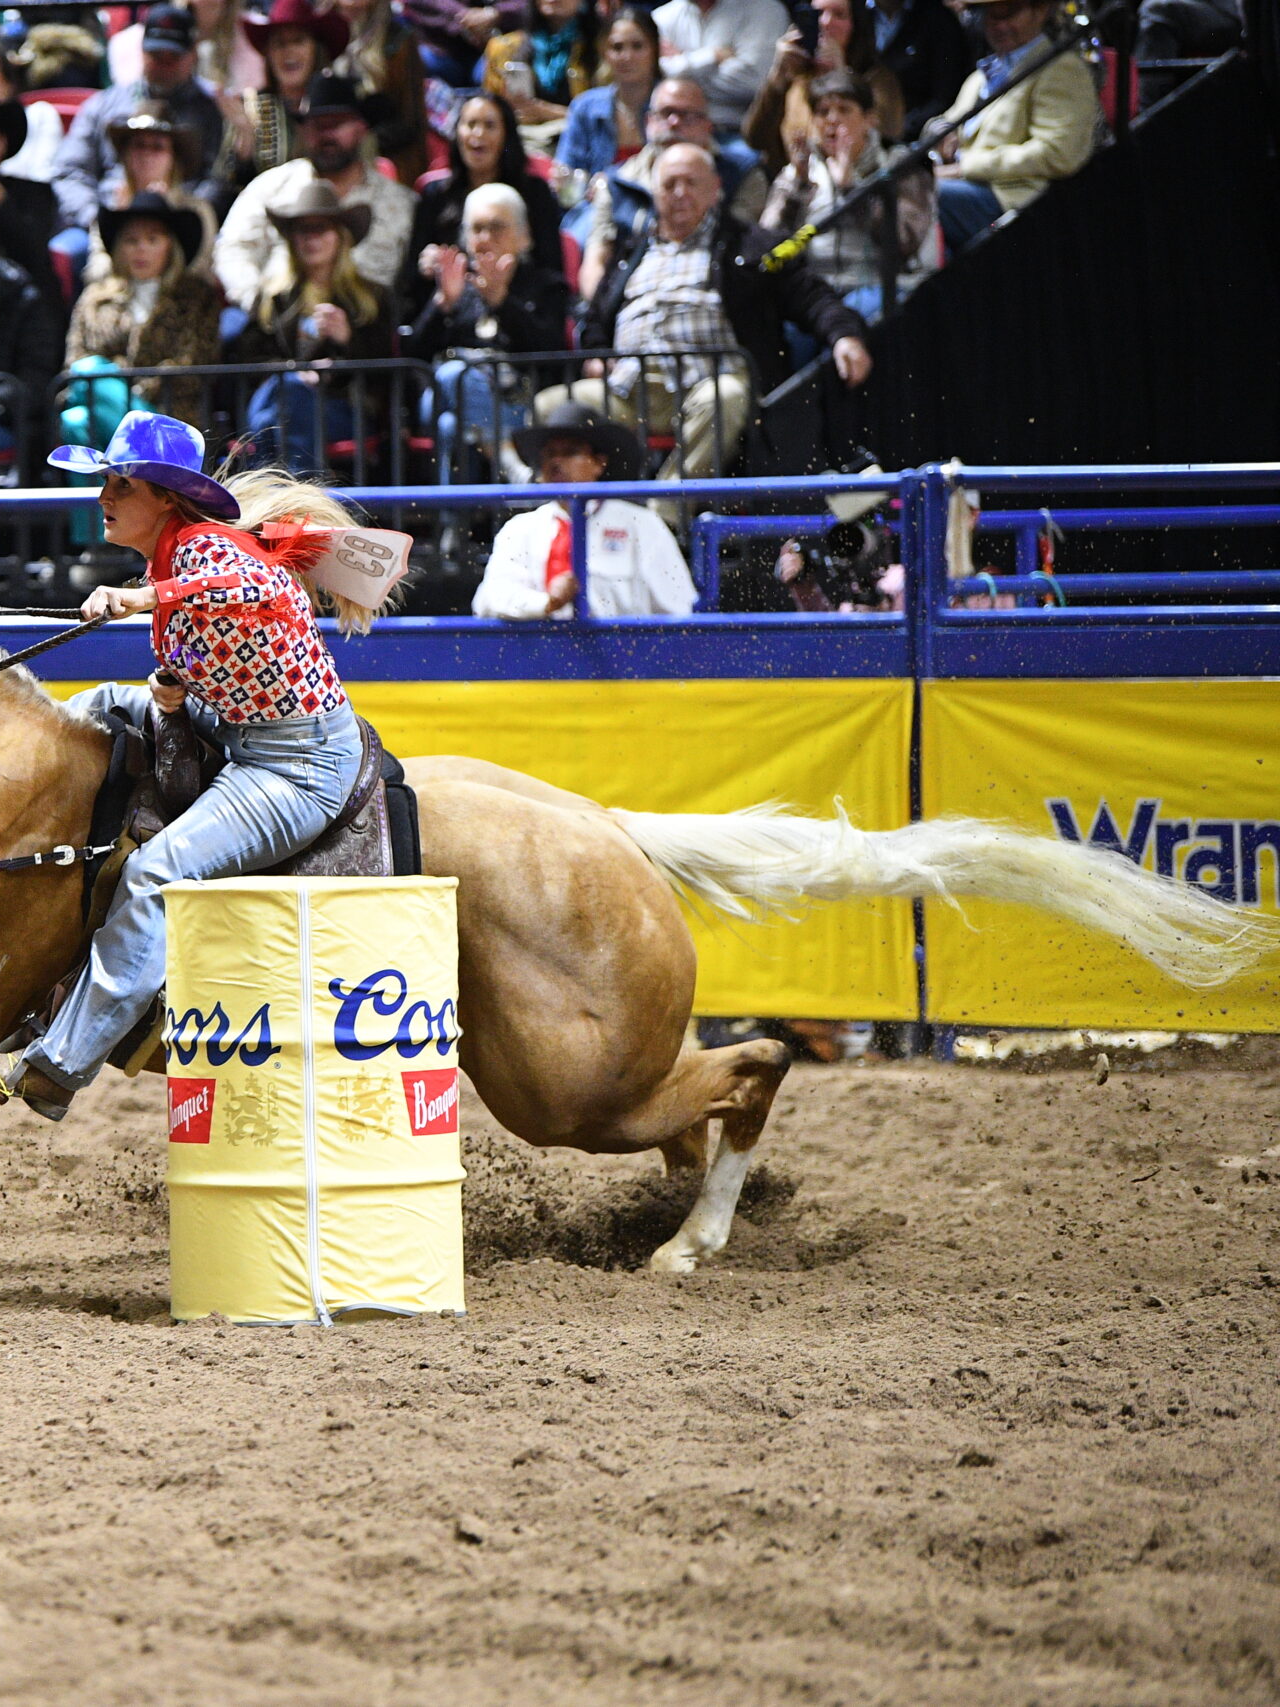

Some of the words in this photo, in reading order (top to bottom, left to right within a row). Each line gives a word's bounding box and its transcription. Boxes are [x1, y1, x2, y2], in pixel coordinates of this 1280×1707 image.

[336, 535, 394, 578] 83
[328, 968, 459, 1061] Coo
[412, 1074, 458, 1130] Banque
